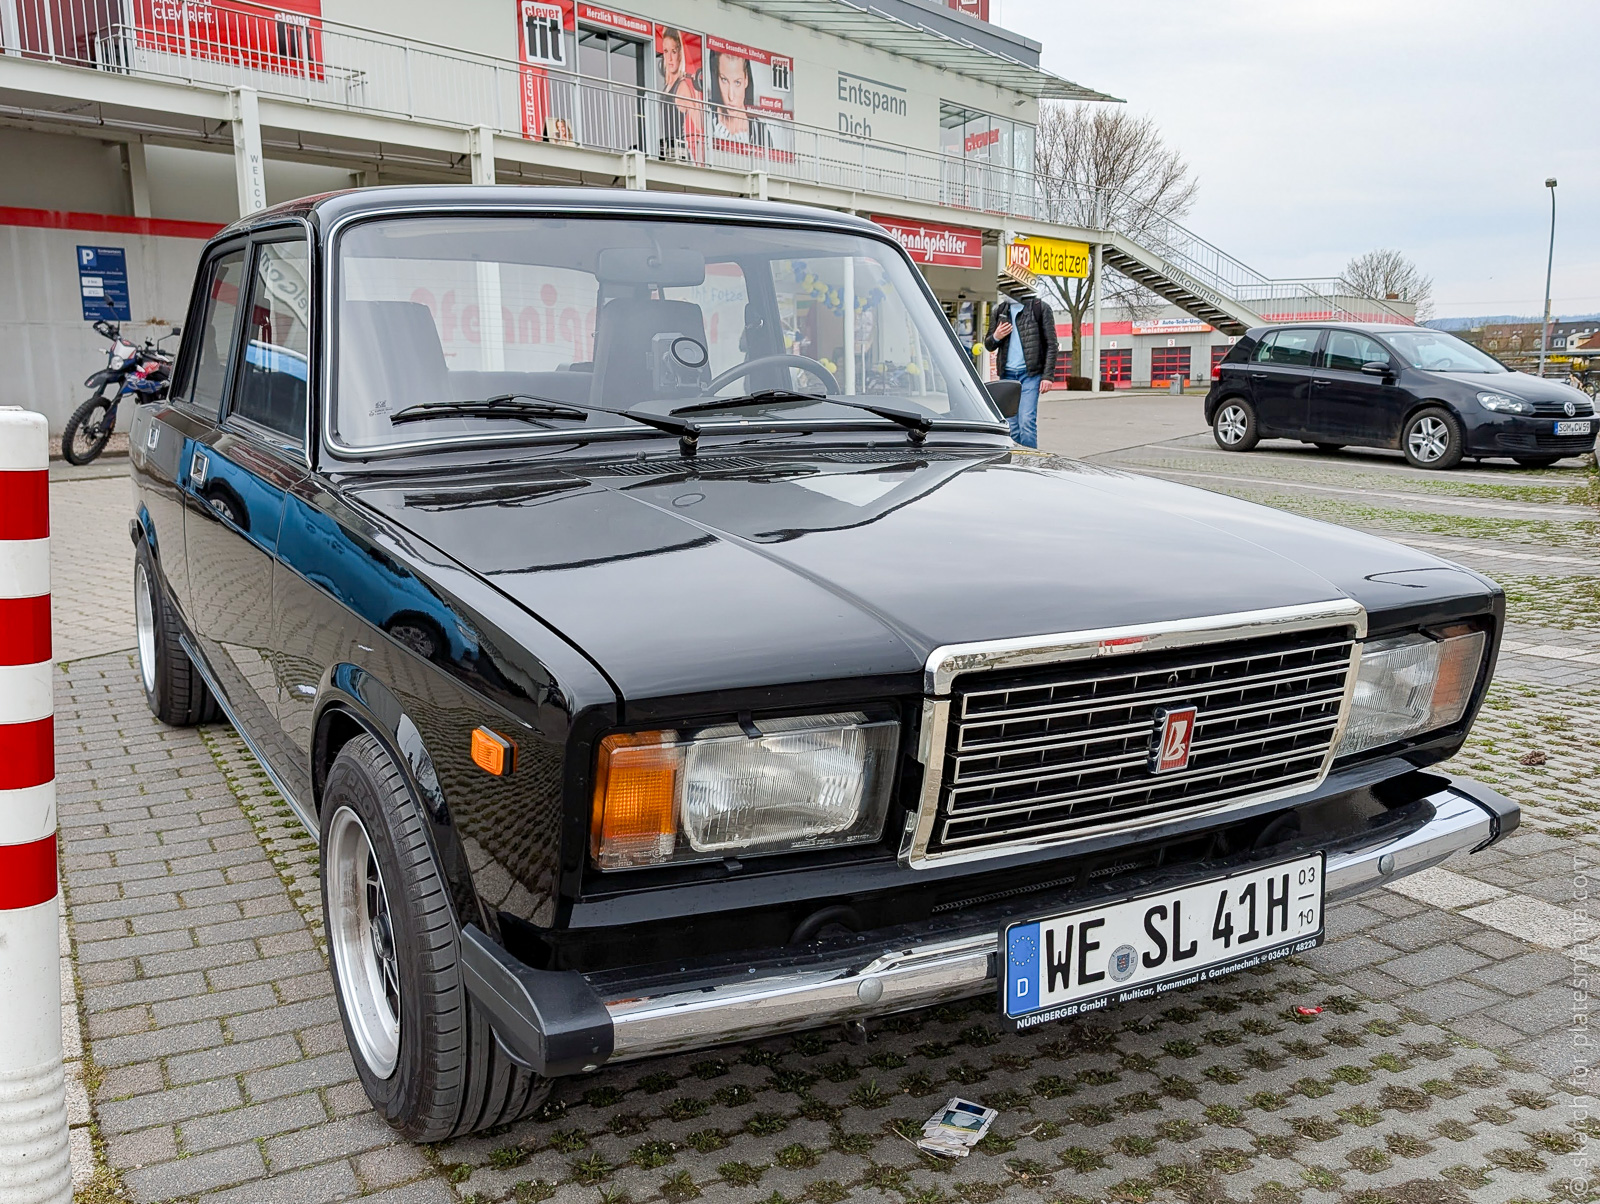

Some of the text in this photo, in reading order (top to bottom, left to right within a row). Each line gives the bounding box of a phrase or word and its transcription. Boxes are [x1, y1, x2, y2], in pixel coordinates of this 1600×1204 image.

[275, 12, 311, 26] clever
[525, 5, 560, 19] clever
[586, 7, 647, 32] Herzlich Willkommen
[526, 16, 563, 62] fit
[708, 38, 767, 60] Fitness. Gesundheit. Lifestyle.
[772, 58, 789, 67] clever
[772, 65, 789, 90] fit
[838, 76, 907, 117] Entspann
[838, 111, 872, 141] Dich
[964, 128, 1000, 152] clever
[1010, 245, 1087, 275] MFO Matratzen
[1161, 262, 1223, 306] Willkommen
[1140, 326, 1203, 334] Meisterwerkstatt
[1298, 867, 1315, 885] 03
[1298, 908, 1314, 927] 10
[1045, 917, 1105, 993] WE
[1142, 900, 1197, 969] SL
[1212, 873, 1290, 949] 41H
[1016, 938, 1317, 1030] NÜRNBERGER GmbH Multicar, Kommunal & Gartentechnik 03643 / 48220
[1017, 977, 1029, 998] D
